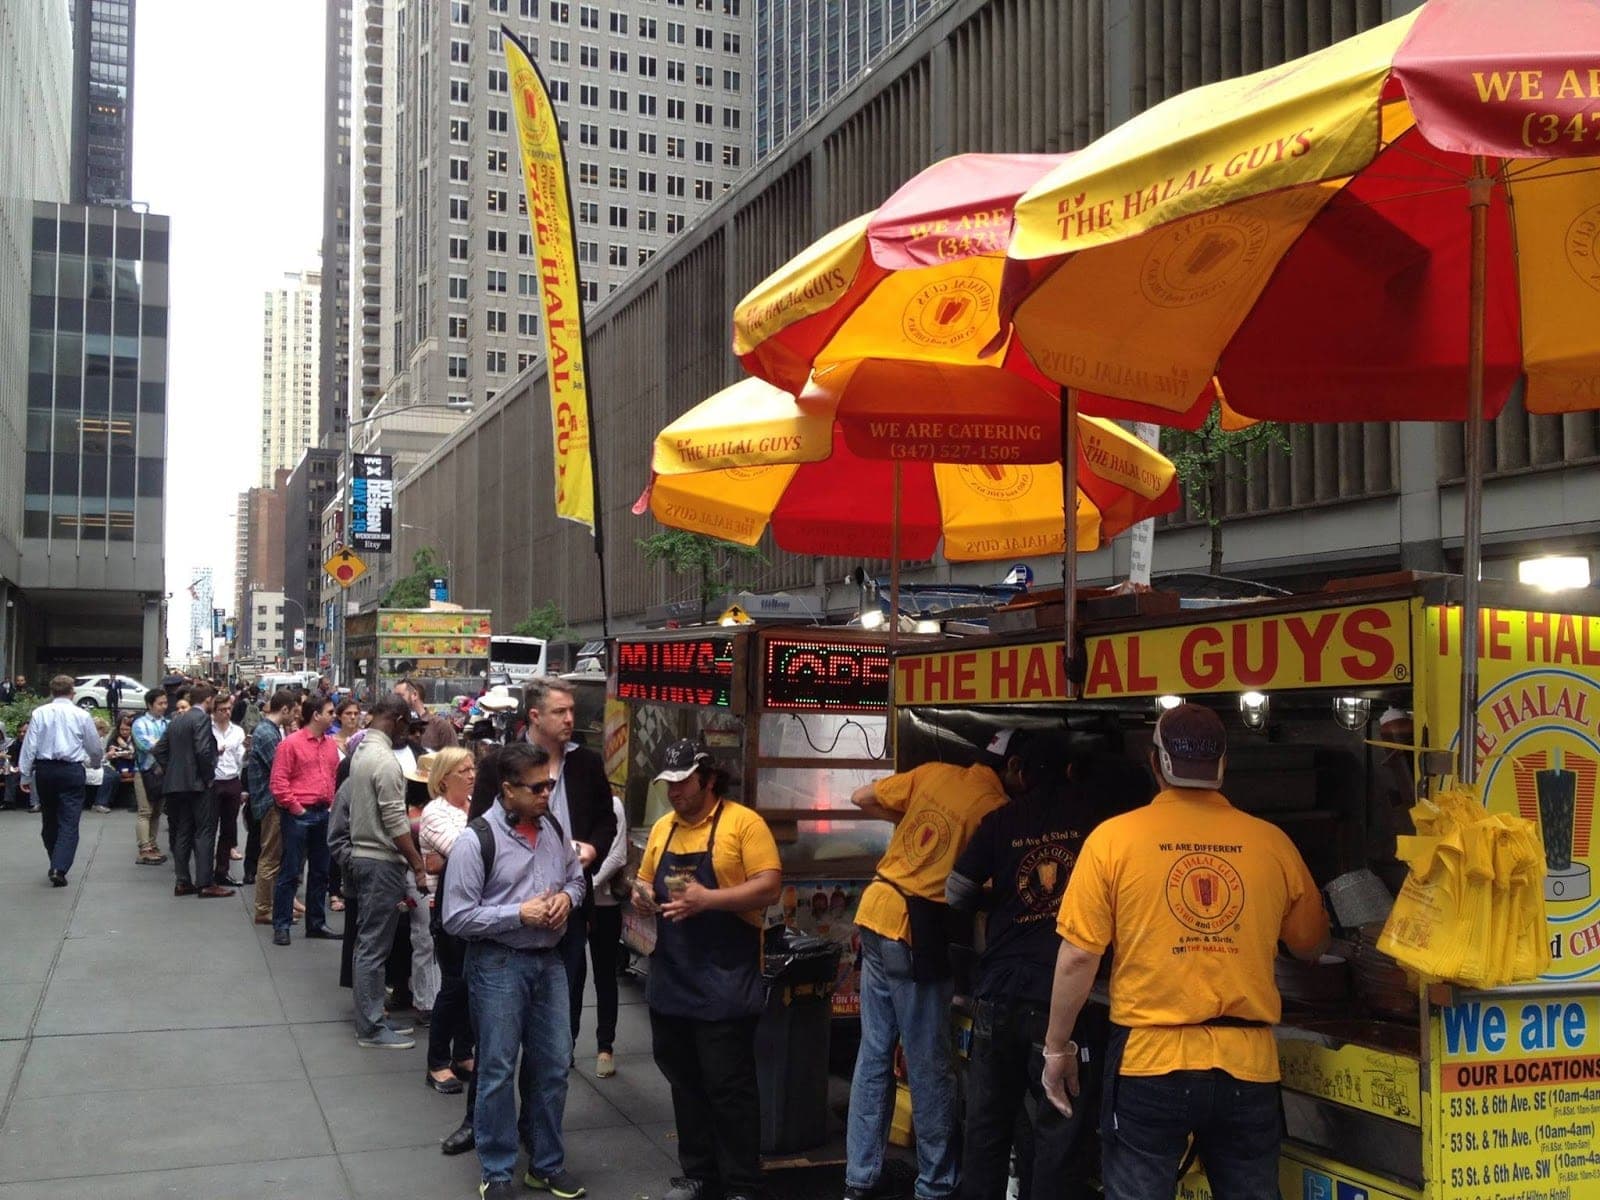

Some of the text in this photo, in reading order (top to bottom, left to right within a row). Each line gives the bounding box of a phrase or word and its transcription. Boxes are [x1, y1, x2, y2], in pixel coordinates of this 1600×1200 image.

[1472, 71, 1544, 103] WE
[1057, 127, 1314, 241] THE HALAL GUYS
[909, 208, 1006, 240] WE ARE
[804, 268, 846, 300] GUYS
[540, 255, 570, 393] HALAL
[869, 422, 1041, 440] WE ARE CATERING
[679, 435, 802, 463] THE HALAL GUYS
[891, 443, 1021, 460] (347) 527-1505
[1086, 445, 1162, 492] THE HALAL GUYS
[353, 478, 367, 502] MAY
[381, 479, 392, 509] NYC
[366, 479, 382, 533] DESIGN
[899, 653, 976, 702] THE
[1179, 608, 1396, 690] GUYS
[1491, 685, 1590, 733] HALAL
[1050, 831, 1069, 841] 53rd
[1159, 843, 1243, 854] WE ARE DIFFERENT
[1169, 856, 1241, 892] THE HALAL GUYS
[1175, 902, 1194, 924] GYRO
[1195, 921, 1211, 929] and
[1443, 1001, 1586, 1054] We are
[1457, 1064, 1498, 1087] OUR
[1451, 1098, 1462, 1117] 53
[1466, 1097, 1478, 1116] St.
[1482, 1096, 1489, 1114] &
[1492, 1094, 1508, 1113] 6th
[1511, 1093, 1531, 1112] Ave.
[1534, 1092, 1546, 1110] SE
[1451, 1121, 1595, 1152] 53 St. & 7th Ave. (10am-4am)
[1452, 1167, 1463, 1188] 53
[1467, 1166, 1480, 1186] St.
[1483, 1165, 1490, 1184] &
[1494, 1163, 1509, 1183] 6th
[1513, 1162, 1533, 1181] Ave.
[1536, 1159, 1551, 1178] SW
